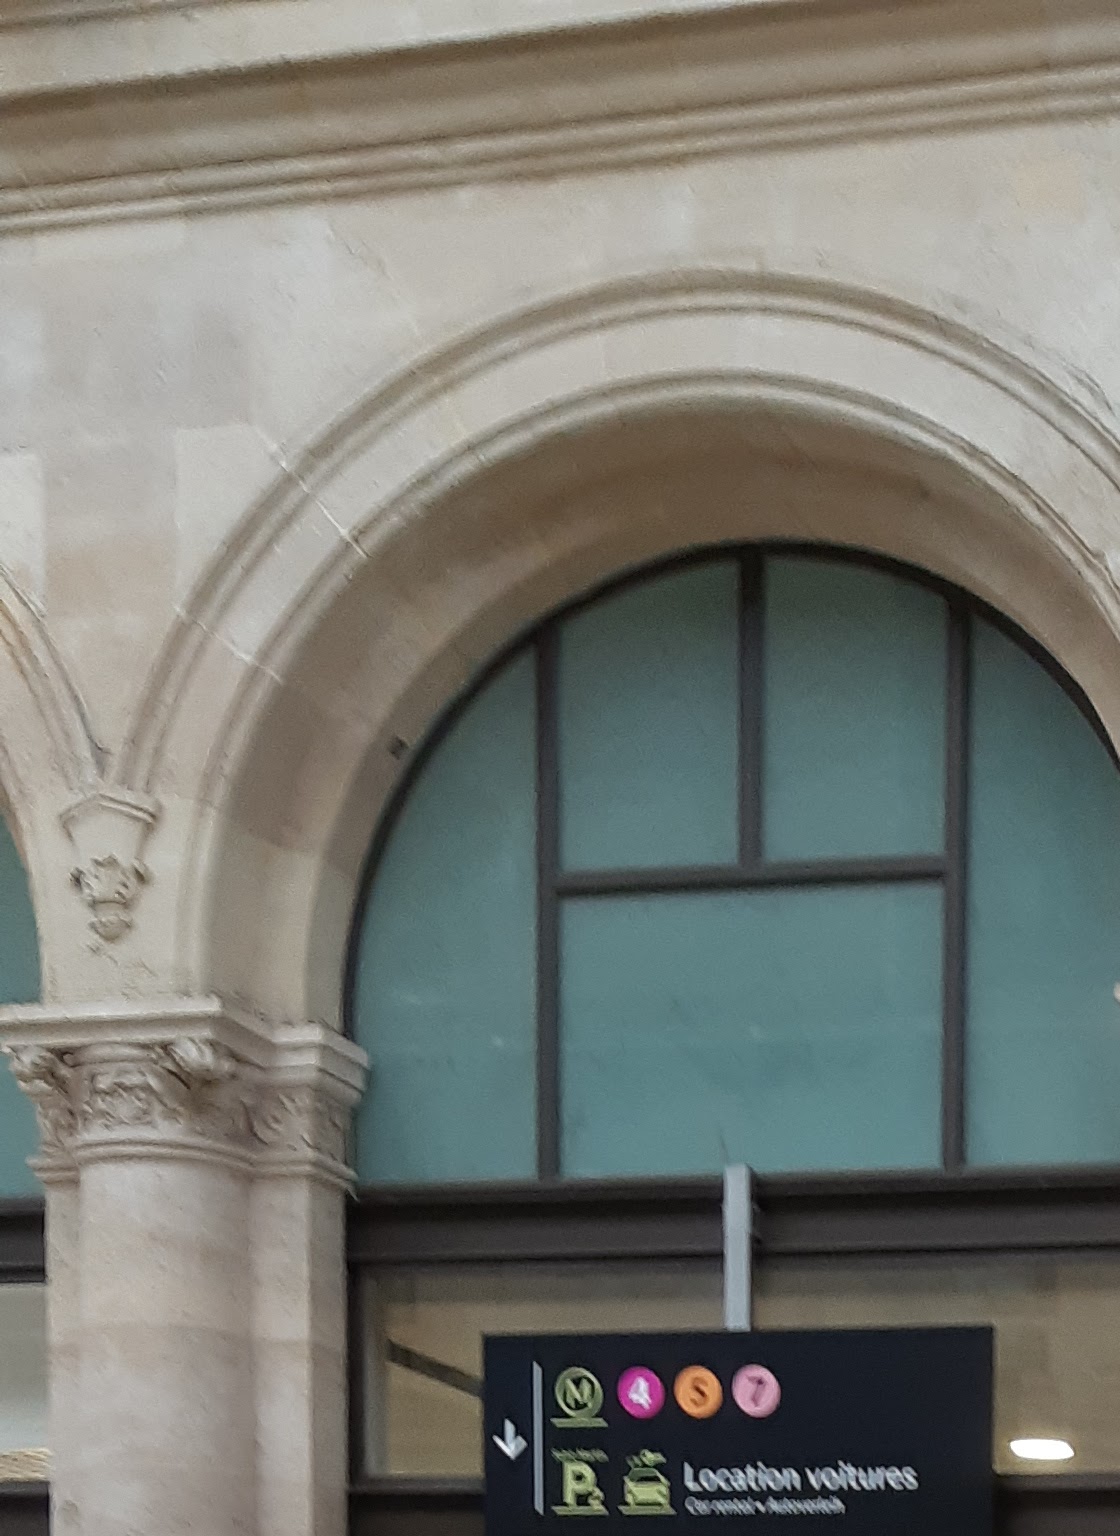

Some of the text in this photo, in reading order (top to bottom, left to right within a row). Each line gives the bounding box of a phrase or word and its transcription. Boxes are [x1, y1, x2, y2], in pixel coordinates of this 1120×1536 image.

[684, 1459, 919, 1492] Location voitures
[684, 1496, 710, 1515] Car
[711, 1496, 752, 1515] rental
